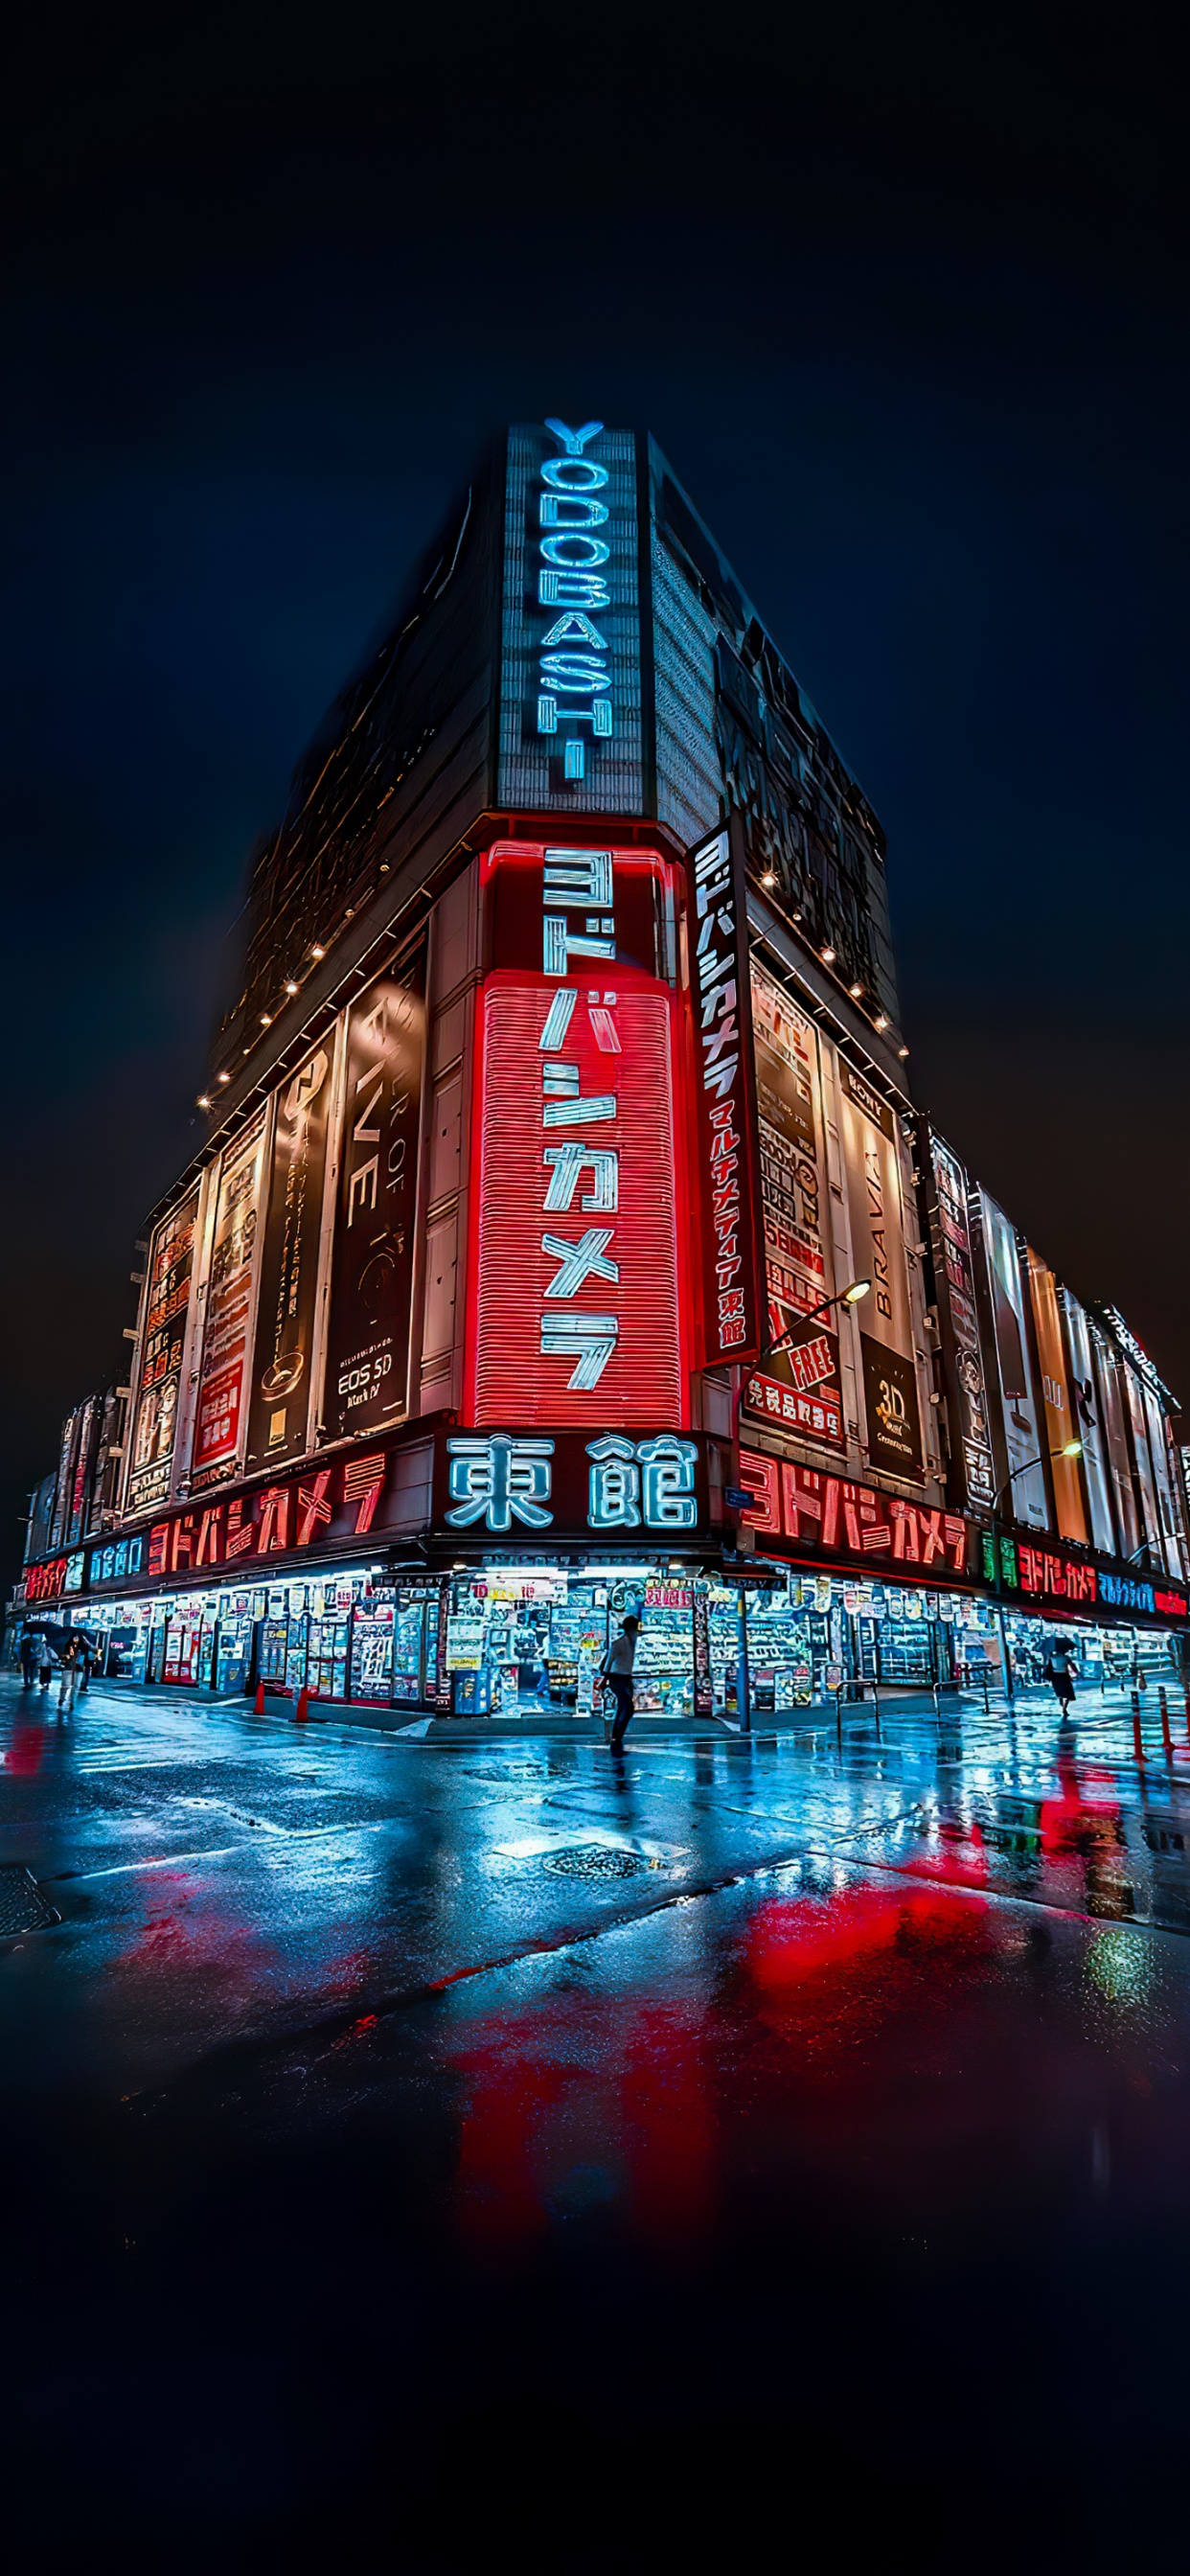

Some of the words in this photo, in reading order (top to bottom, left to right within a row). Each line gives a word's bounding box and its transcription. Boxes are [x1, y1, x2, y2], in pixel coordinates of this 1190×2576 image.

[537, 417, 613, 780] YODOBASHI
[695, 830, 739, 1099] ヨドバシカメラ
[538, 847, 622, 1392] ヨドバシカメラ
[338, 1365, 371, 1394] EOS
[374, 1353, 392, 1379] 5D
[790, 1338, 835, 1388] FREE
[879, 1378, 905, 1421] 3D
[149, 1453, 386, 1576] ヨドバシカメラ
[444, 1433, 699, 1532] 東館
[740, 1450, 966, 1571] ヨドバシカメラ
